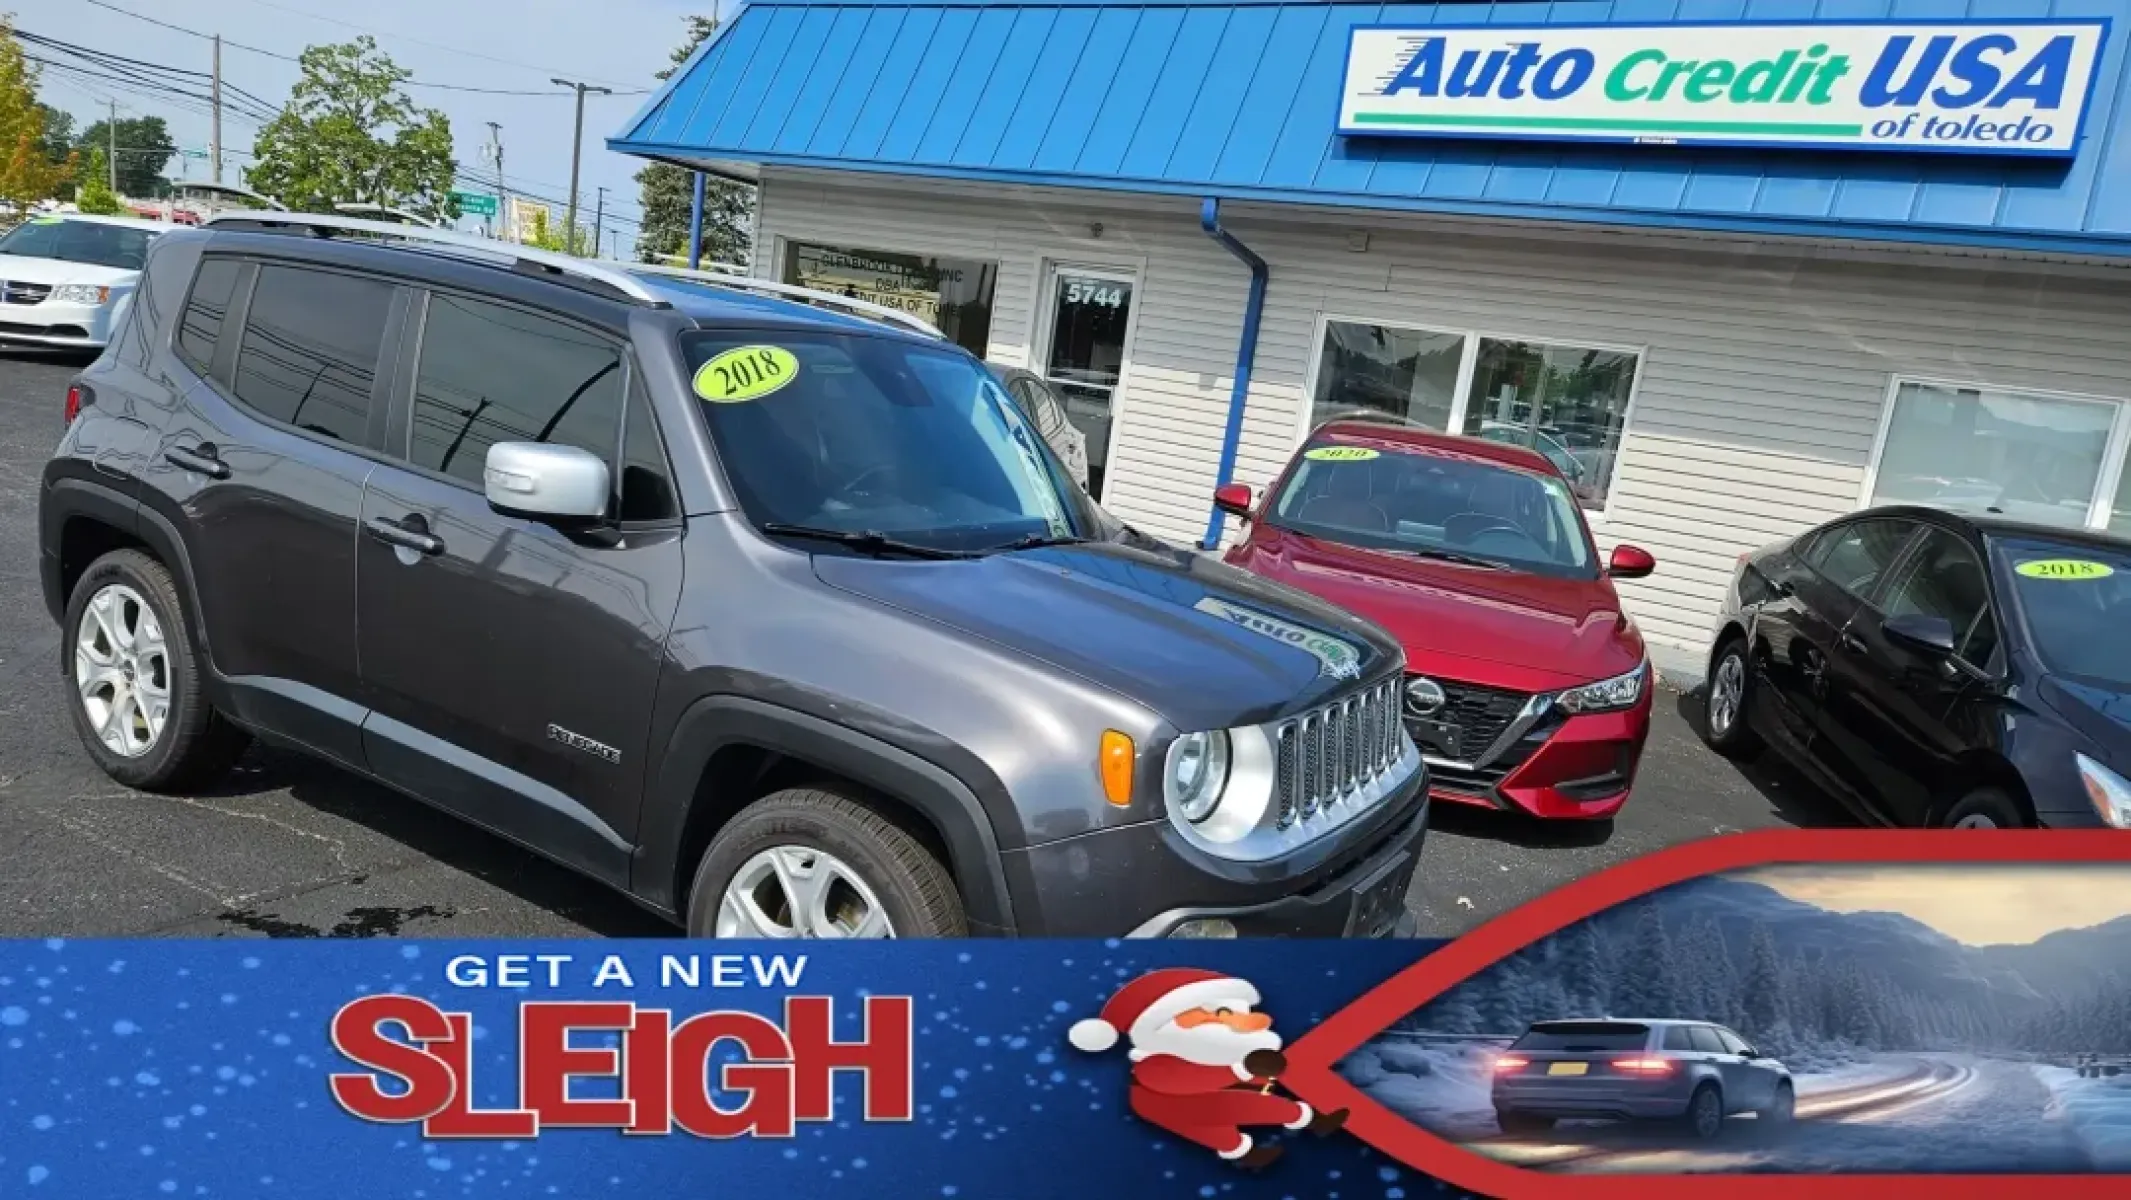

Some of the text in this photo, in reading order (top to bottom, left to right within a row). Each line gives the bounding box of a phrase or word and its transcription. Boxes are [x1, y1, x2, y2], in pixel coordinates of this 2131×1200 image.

[1378, 33, 2076, 109] Auto Credit USA
[1870, 112, 2053, 142] of toledo
[1066, 283, 1121, 308] 5744
[714, 350, 780, 395] 2018
[2036, 563, 2094, 575] 2018
